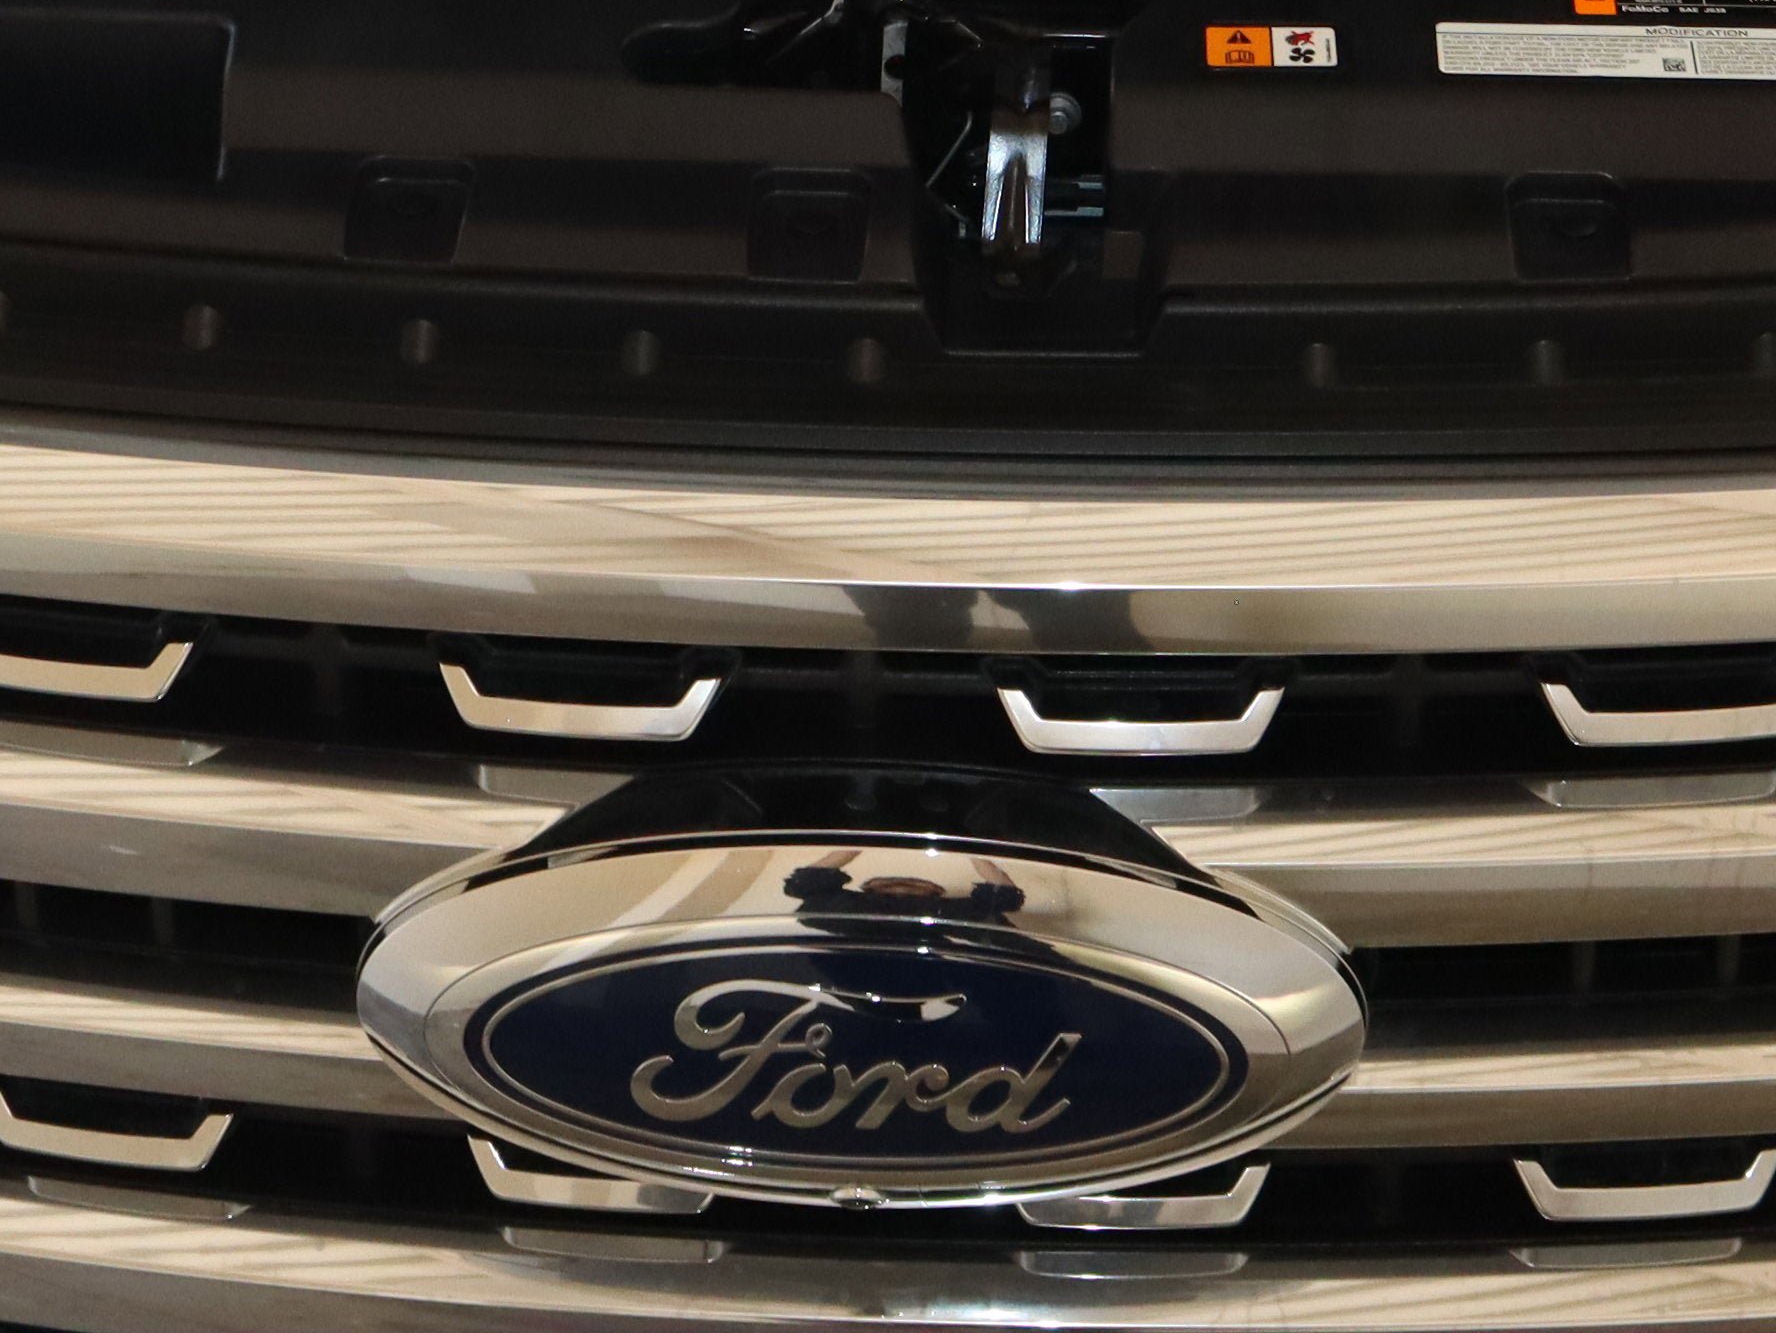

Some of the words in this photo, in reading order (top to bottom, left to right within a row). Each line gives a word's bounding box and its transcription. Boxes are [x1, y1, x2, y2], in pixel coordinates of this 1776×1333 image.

[1621, 5, 1669, 14] FoMoCo
[1645, 27, 1749, 38] MODIFICATION
[630, 978, 1083, 1134] Ford
